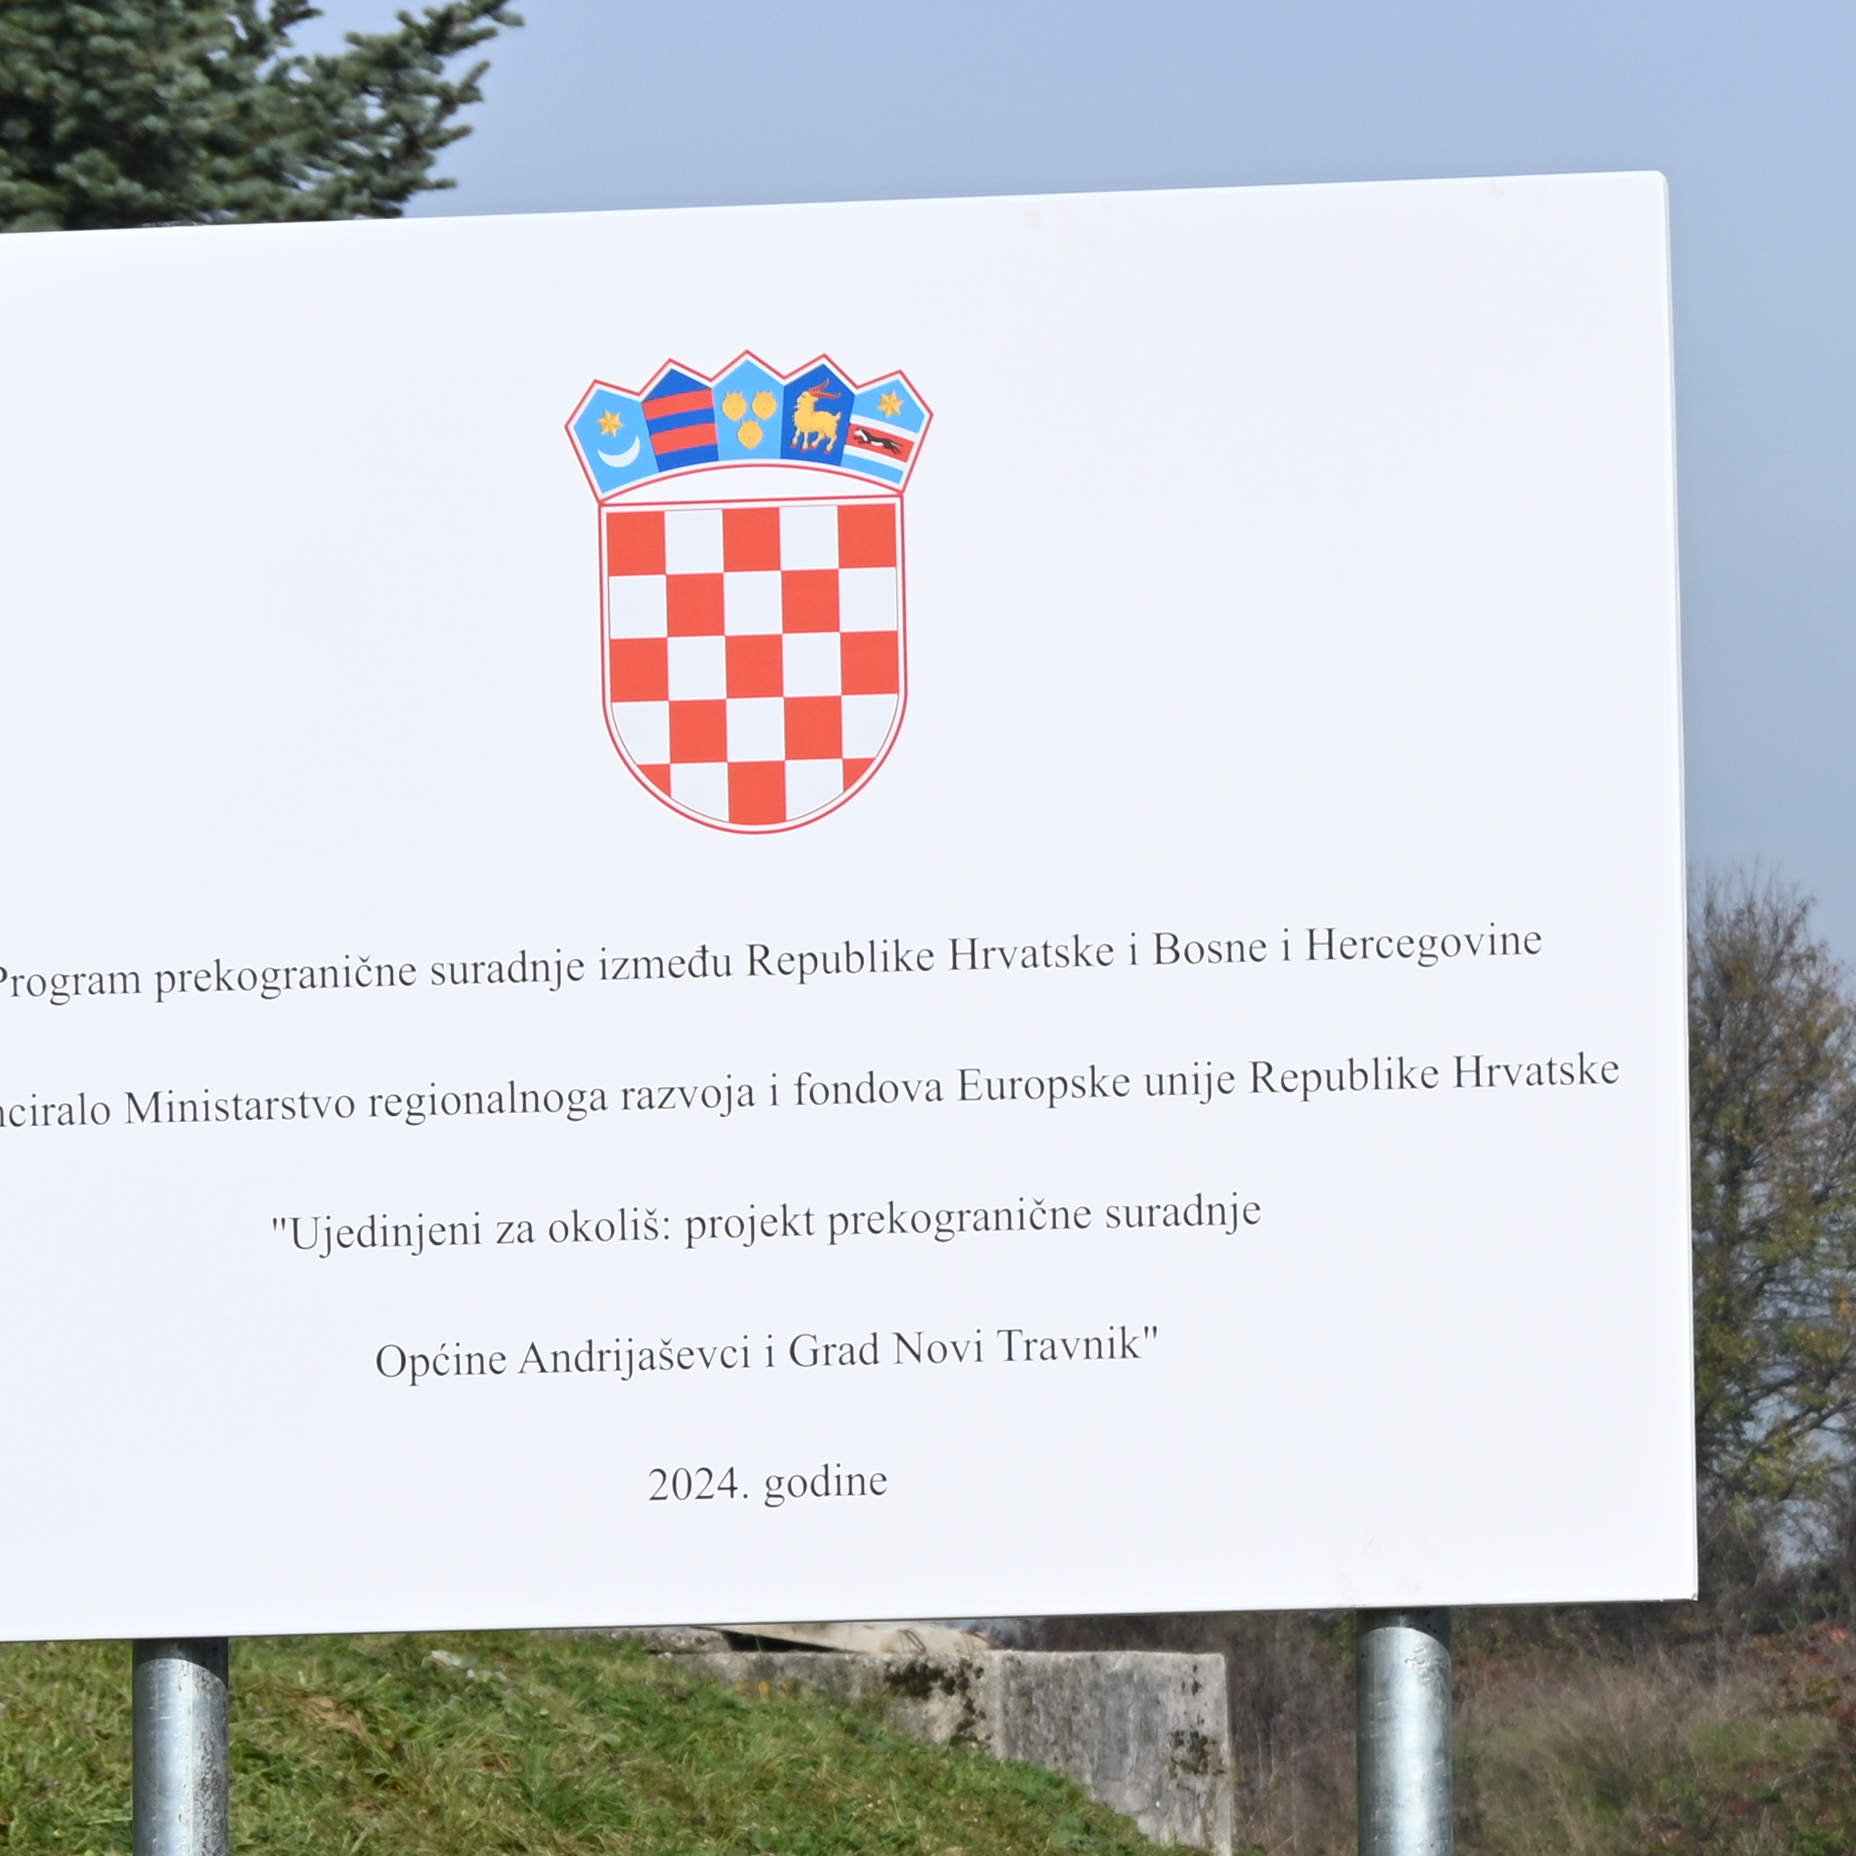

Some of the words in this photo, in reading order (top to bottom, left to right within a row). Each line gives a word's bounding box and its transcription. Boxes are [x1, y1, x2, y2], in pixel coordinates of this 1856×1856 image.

[155, 955, 416, 1003] prekogranične
[432, 949, 584, 992] suradnje
[600, 944, 731, 980] između
[748, 939, 934, 985] Republike
[950, 934, 1113, 970] Hrvatske
[1127, 931, 1139, 966] i
[1155, 931, 1267, 965] Bosne
[1281, 927, 1293, 962] i
[1308, 922, 1542, 967] Hercegovine
[125, 1089, 355, 1123] Ministarstvo
[370, 1080, 608, 1125] regionalnoga
[622, 1074, 755, 1117] razvoja
[768, 1072, 780, 1106] i
[794, 1071, 943, 1105] fondova
[958, 1064, 1130, 1108] Europske
[1145, 1061, 1235, 1104] unije
[1250, 1056, 1439, 1102] Republike
[1454, 1051, 1619, 1088] Hrvatske
[273, 1212, 481, 1258] "Ujedinjeni
[496, 1221, 535, 1244] za
[549, 1207, 670, 1243] okoliš:
[685, 1204, 814, 1248] projekt
[829, 1197, 1091, 1245] prekogranične
[1106, 1192, 1261, 1235] suradnje
[376, 1343, 507, 1386] Općine
[518, 1334, 750, 1381] Andrijaševci
[764, 1333, 776, 1368] i
[789, 1332, 879, 1367] Grad
[893, 1329, 983, 1364] Novi
[997, 1325, 1158, 1361] Travnik"
[648, 1467, 749, 1501] 2024.
[764, 1463, 888, 1507] godine
